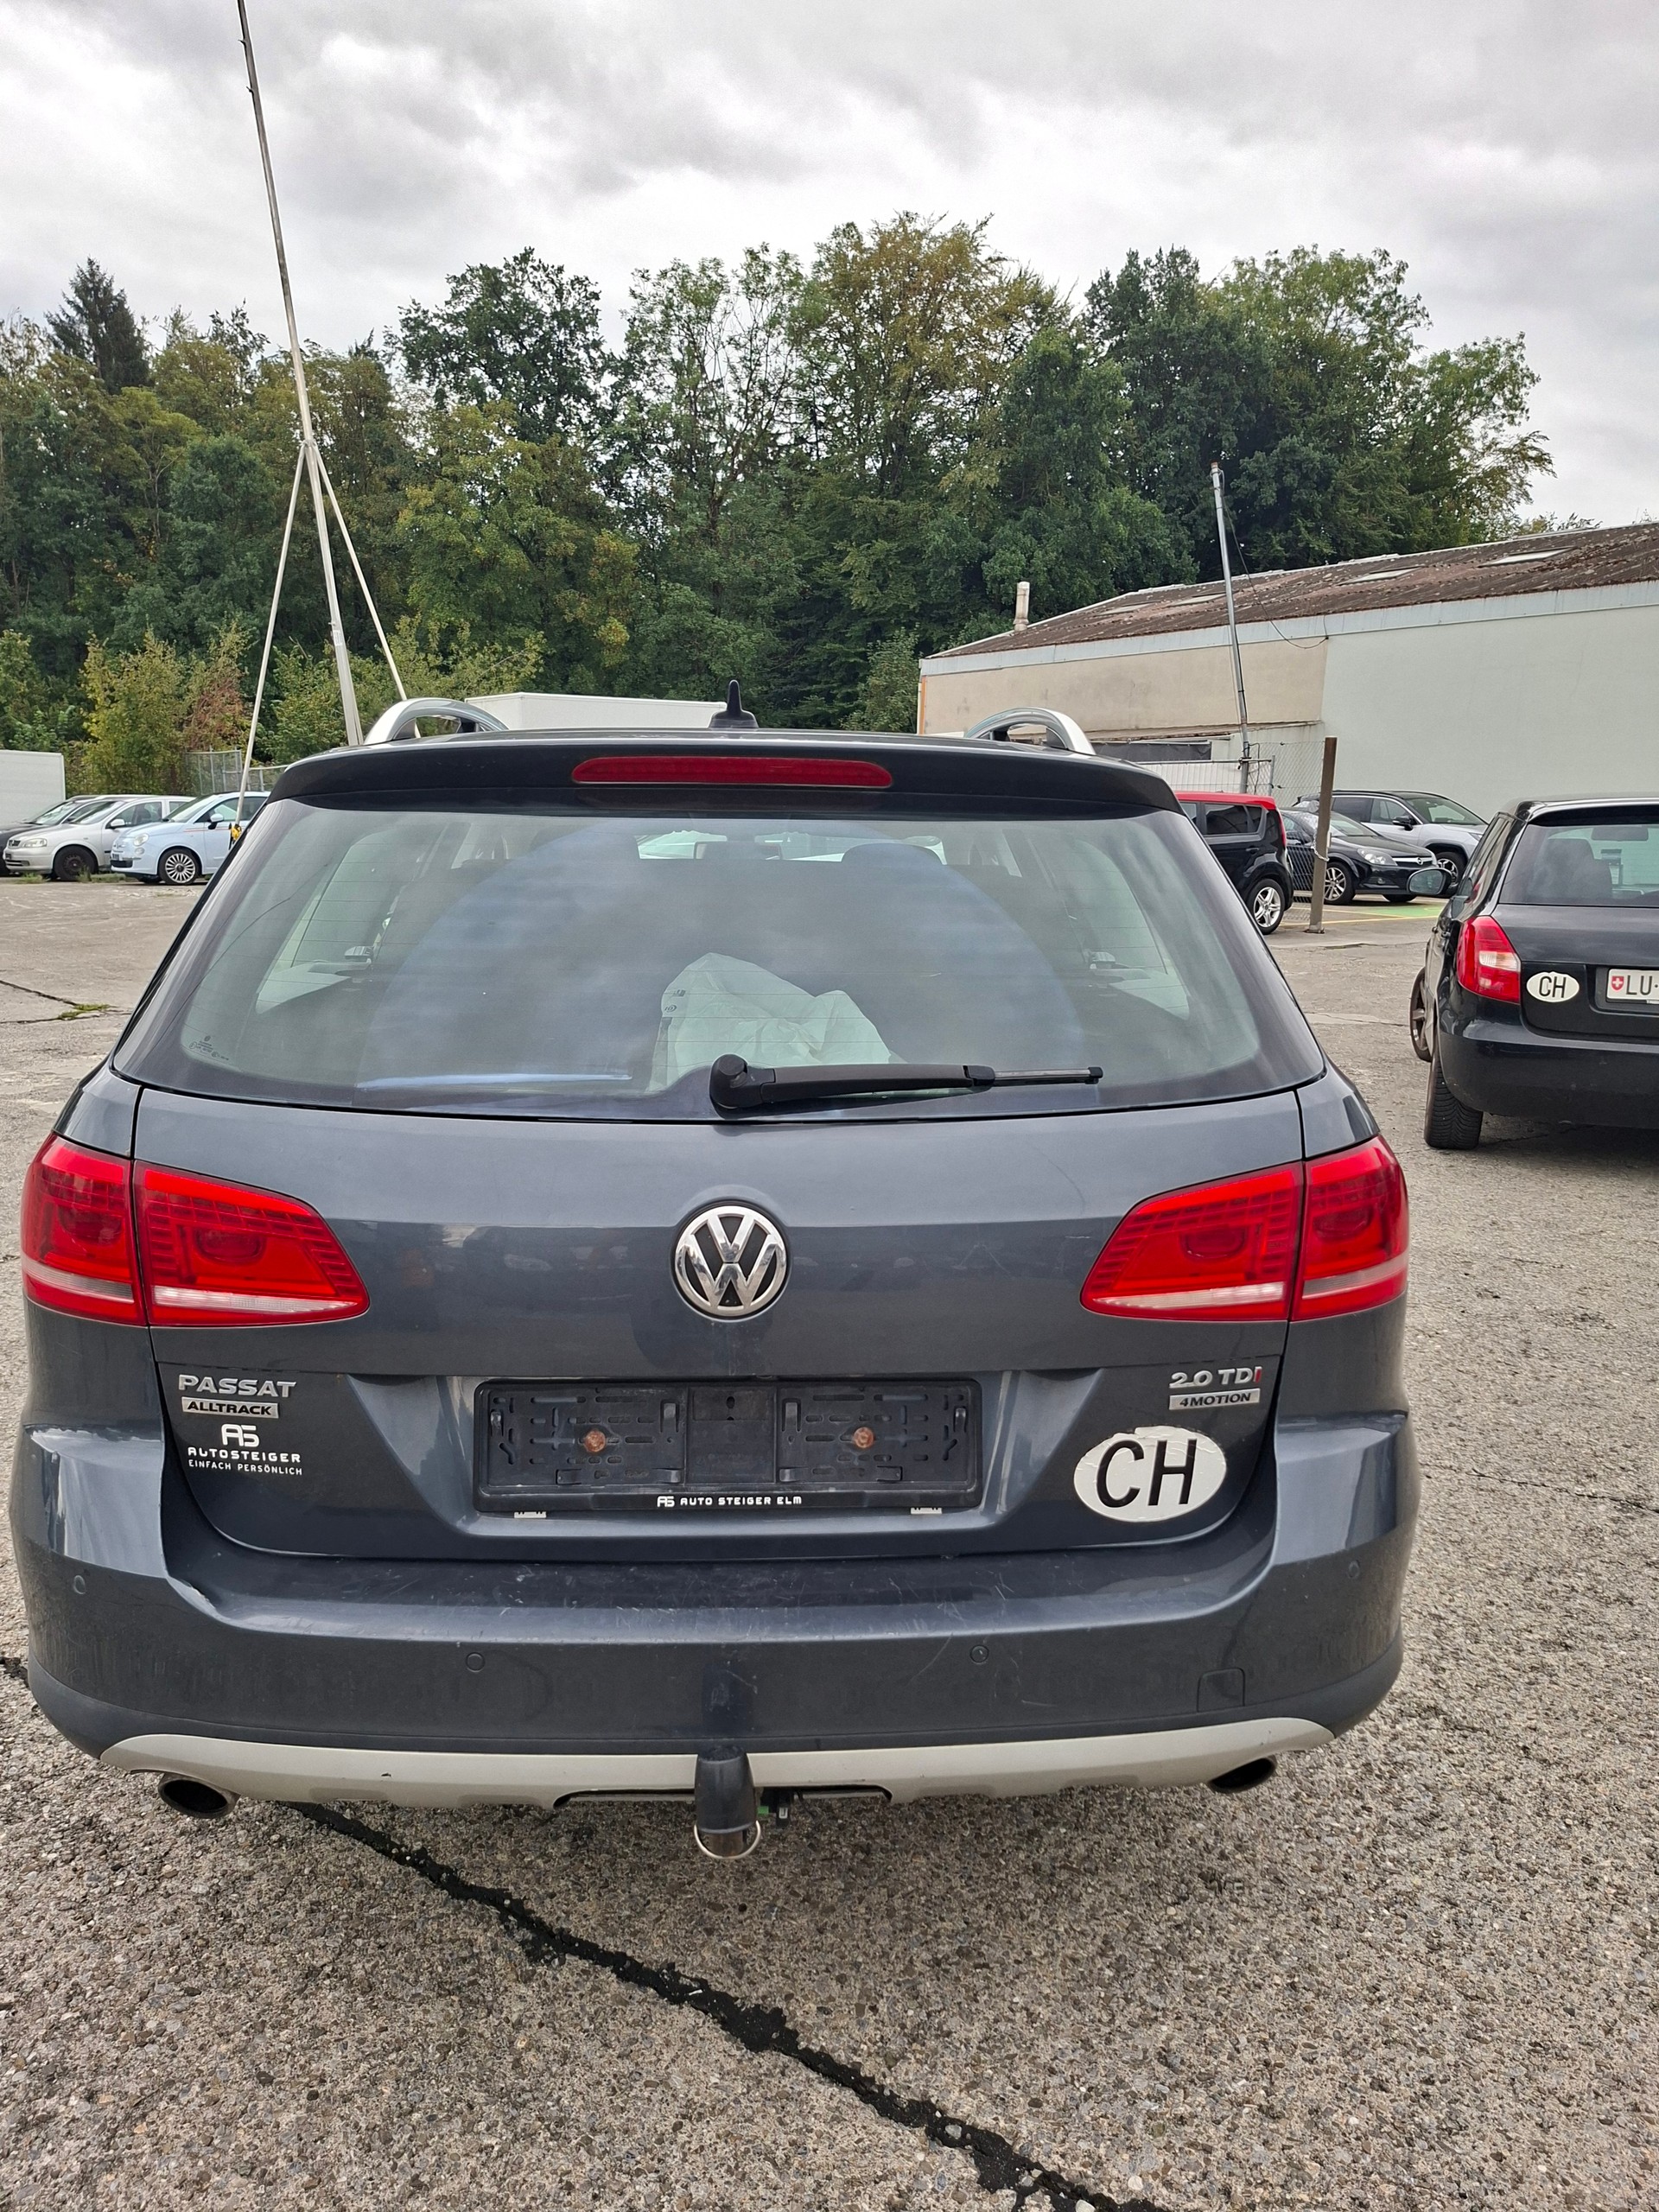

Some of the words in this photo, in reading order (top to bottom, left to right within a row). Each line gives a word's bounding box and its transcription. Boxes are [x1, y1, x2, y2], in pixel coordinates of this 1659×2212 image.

[1538, 976, 1567, 999] CH
[1217, 1366, 1263, 1384] TDI
[178, 1374, 296, 1398] PASSAT
[187, 1401, 271, 1415] ALLTRACK
[1179, 1392, 1251, 1408] 4MOTION
[188, 1446, 301, 1463] AUTOSTEIGER
[188, 1459, 232, 1471] EINFACH
[237, 1463, 302, 1476] PERSÖNLICH
[1096, 1438, 1198, 1509] CH
[680, 1497, 713, 1505] AUTO
[718, 1497, 772, 1505] STEIGER
[777, 1496, 802, 1504] ELM
